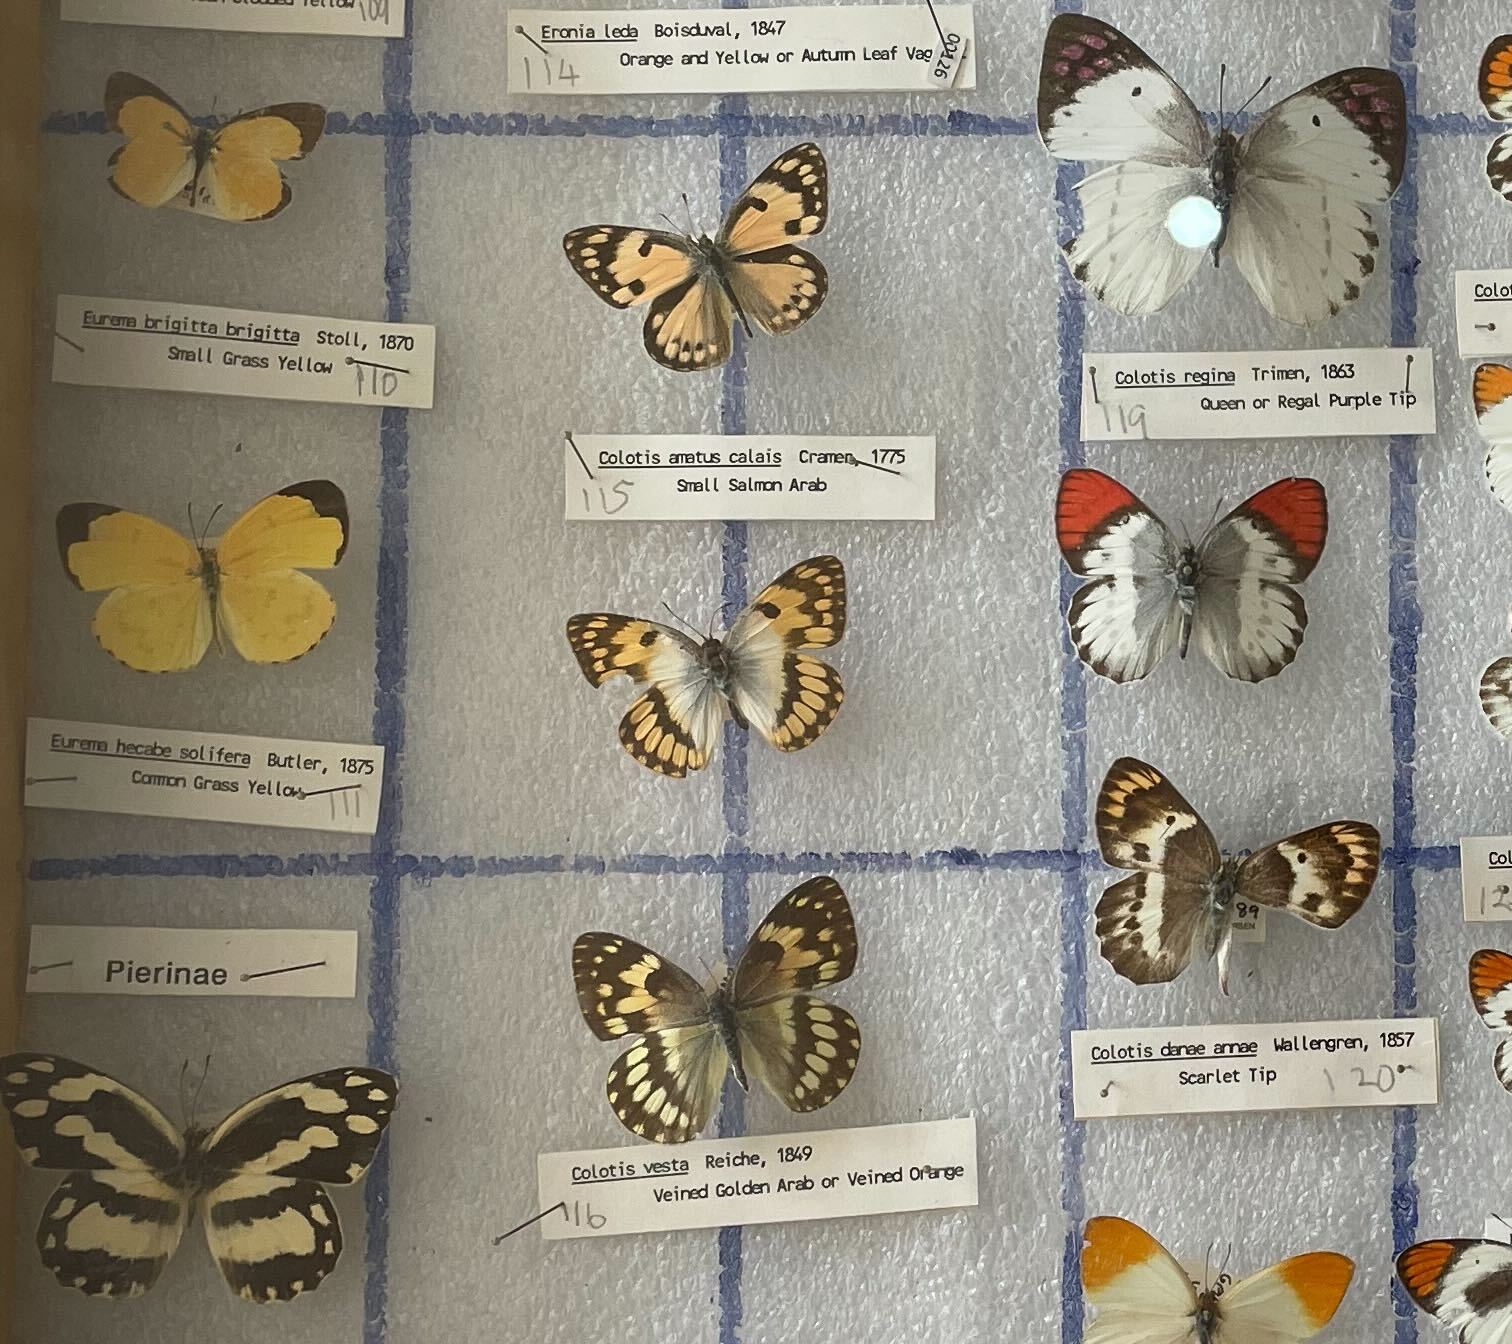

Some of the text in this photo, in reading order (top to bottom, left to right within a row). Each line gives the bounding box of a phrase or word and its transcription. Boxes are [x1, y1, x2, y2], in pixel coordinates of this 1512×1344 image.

[620, 51, 673, 69] Orange
[681, 51, 708, 65] and
[716, 50, 769, 66] Yellow
[776, 50, 794, 64] or
[863, 46, 897, 62] Leaf
[83, 311, 414, 351] Eurema brigitta brigitta Stoll, 1870
[168, 347, 332, 374] Small Grass Yellow
[1115, 365, 1355, 385] Colotis regina Trimen, 1863
[1201, 392, 1416, 411] Queen or Regal Purple Tip
[677, 479, 827, 492] Small Salmon Arab
[132, 770, 186, 787] Common
[194, 776, 239, 792] Grass
[105, 959, 228, 986] Pierinae
[1179, 1068, 1277, 1085] Scarlet Tip
[654, 1165, 964, 1202] Veined Golden Arab or Veined Orange
